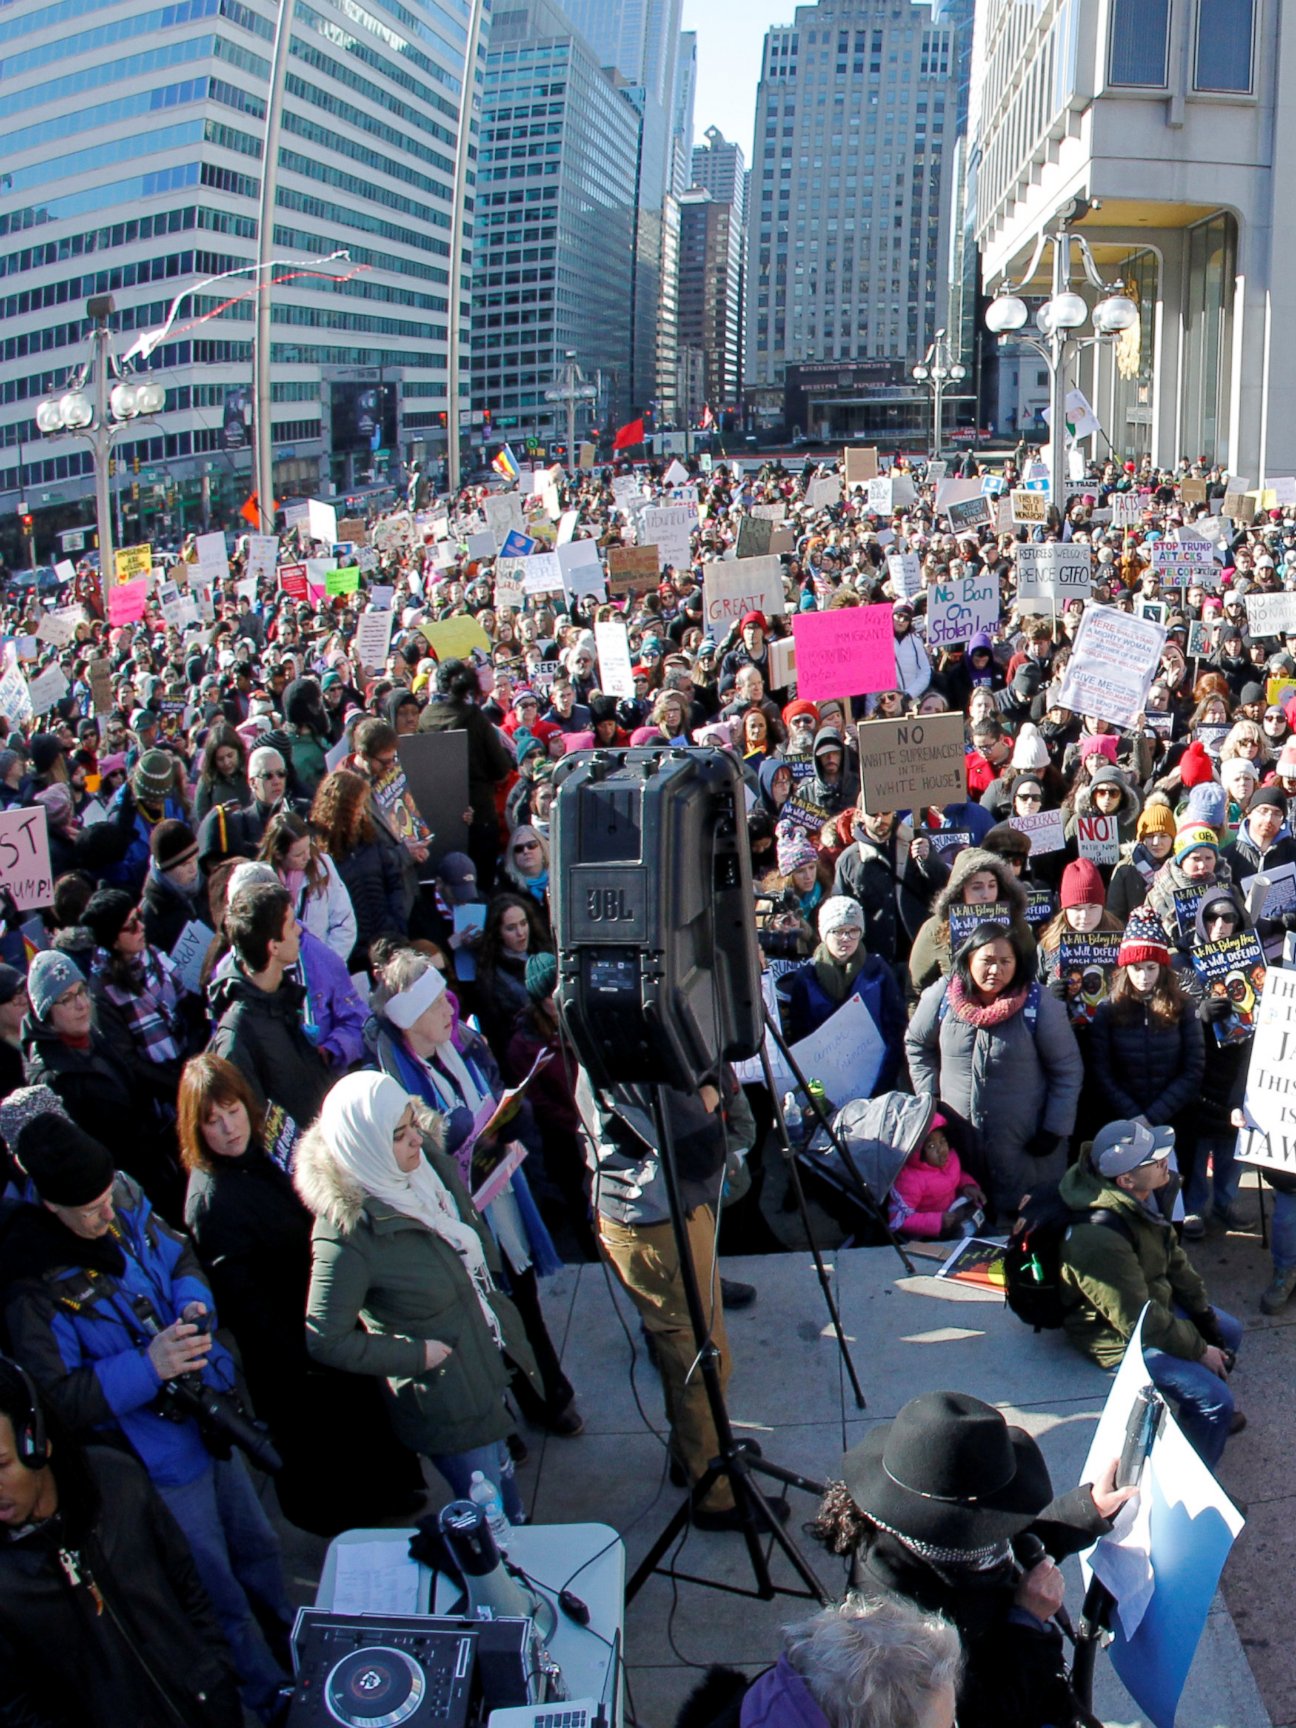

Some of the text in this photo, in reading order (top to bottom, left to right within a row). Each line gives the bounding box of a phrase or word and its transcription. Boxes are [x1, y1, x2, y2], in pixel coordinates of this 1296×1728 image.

[1116, 495, 1138, 512] FACTS
[1019, 548, 1088, 560] REFUGEES WELCOME
[1153, 542, 1212, 552] STOP TRUMP
[1159, 551, 1203, 561] ATTACKS
[1018, 566, 1089, 585] PENCE GTFO
[935, 578, 993, 605] No Ban
[709, 593, 766, 620] GREAT!
[1248, 595, 1266, 608] NO
[946, 604, 972, 621] On
[1248, 609, 1268, 622] NO
[929, 616, 973, 645] Stolen
[1090, 618, 1116, 632] HERE
[1249, 622, 1262, 633] NO
[1093, 629, 1122, 643] MIGHTY
[1123, 640, 1152, 653] WOMAN
[1072, 671, 1112, 690] GIVE ME
[897, 726, 924, 746] NO
[861, 742, 964, 768] WHITE SUPREMACISTS
[899, 764, 927, 774] IN THE
[875, 768, 962, 796] WHITE HOUSE!
[1078, 815, 1116, 842] NO!
[0, 815, 37, 870] ST
[2, 878, 51, 901] RUMP!
[587, 888, 635, 922] JBL
[962, 905, 975, 916] ALL
[1073, 934, 1089, 945] ALL
[1093, 947, 1121, 958] DEFEN
[1204, 943, 1219, 956] ALL
[1226, 945, 1260, 963] DEFEND
